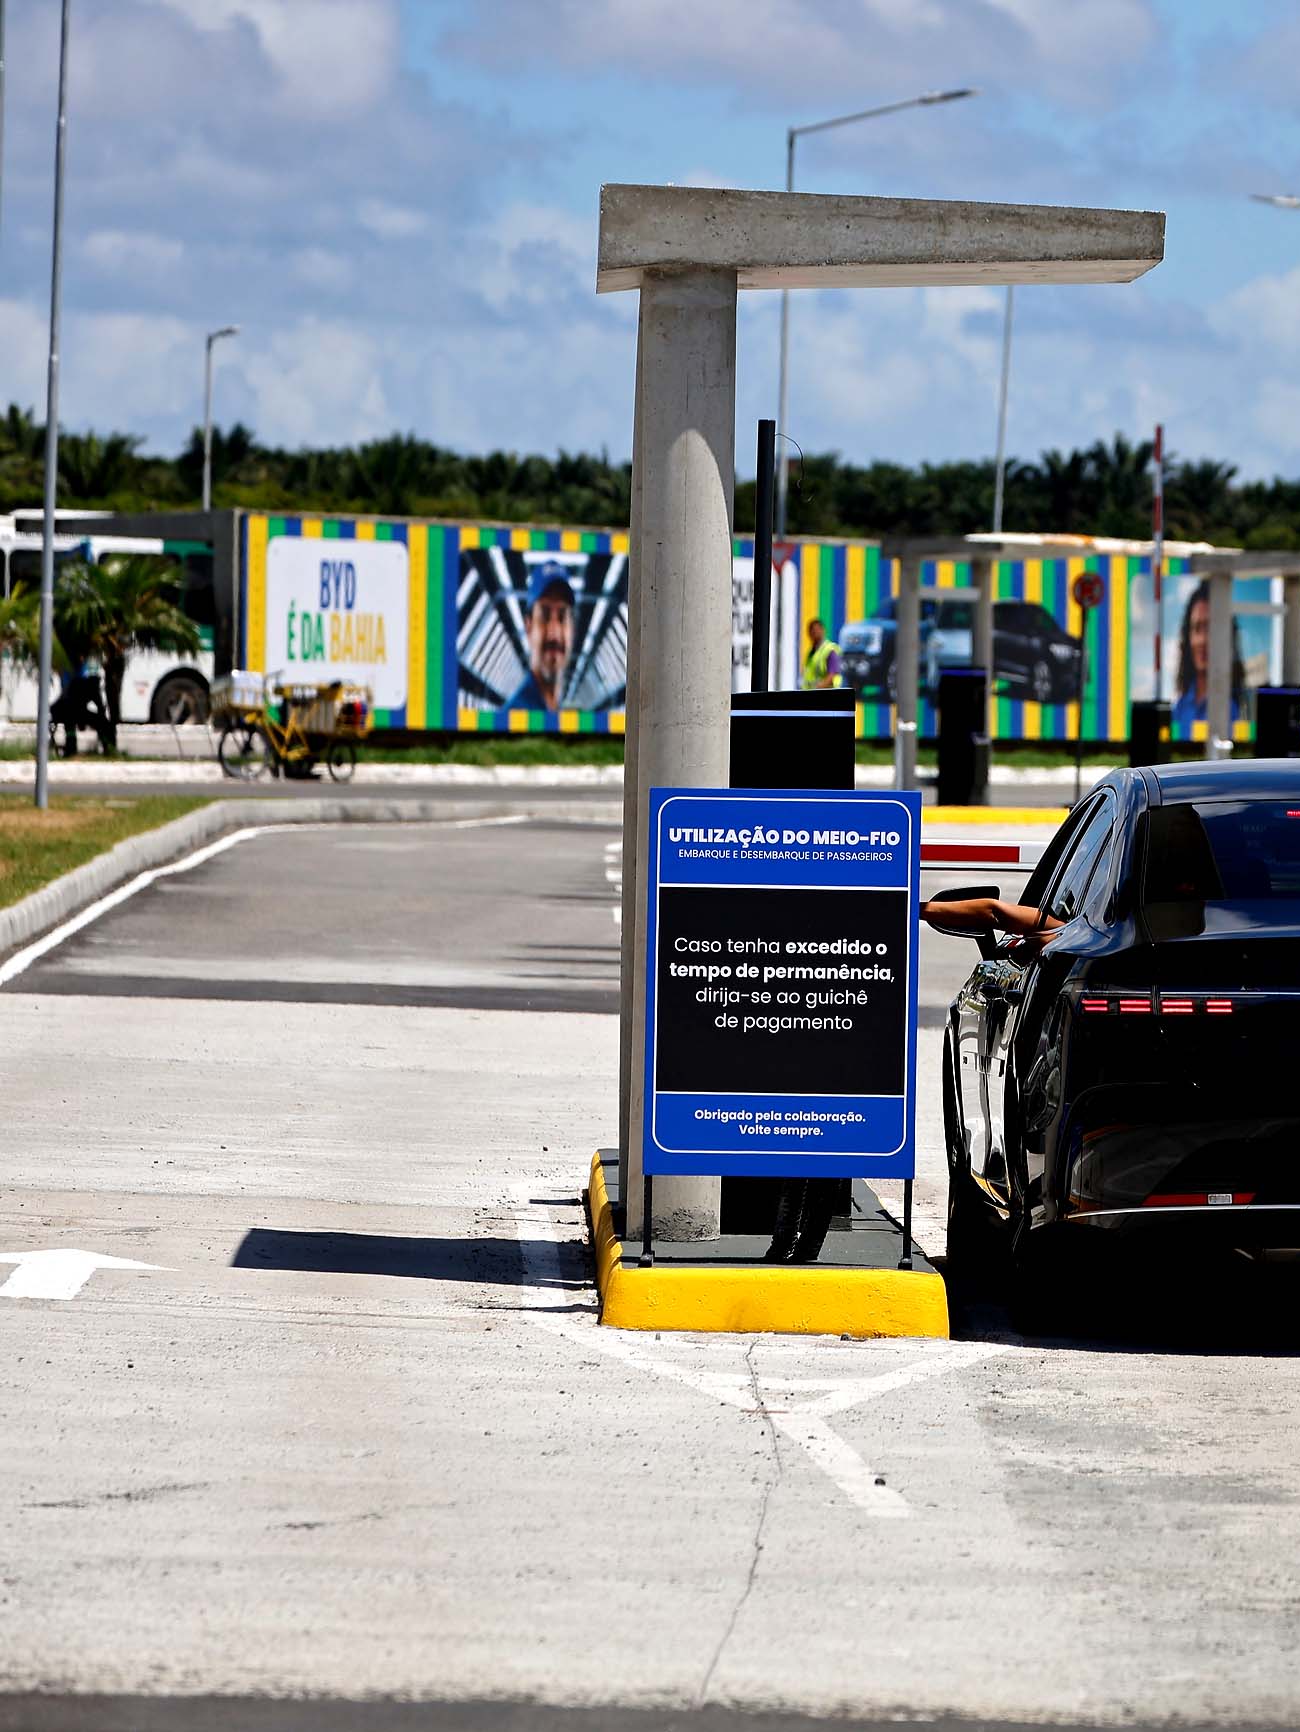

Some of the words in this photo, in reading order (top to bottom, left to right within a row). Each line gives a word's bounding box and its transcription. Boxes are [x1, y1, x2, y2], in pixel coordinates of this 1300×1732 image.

[320, 560, 356, 609] BYD
[287, 598, 296, 661] É
[301, 611, 325, 661] DA
[330, 611, 386, 663] BAHIA
[669, 825, 780, 849] UTILIZAÇÃO
[782, 829, 811, 845] DO
[812, 830, 901, 846] MEIO-FIO
[678, 848, 731, 860] EMBARQUE
[732, 849, 739, 859] E
[740, 850, 810, 861] DESEMBARQUE
[812, 851, 825, 861] DE
[826, 851, 893, 862] PASSAGEIROS
[674, 937, 722, 953] Caso
[726, 937, 780, 954] tenha
[785, 938, 872, 955] excedido
[875, 943, 888, 956] o
[669, 962, 732, 983] tempo
[735, 962, 760, 979] de
[763, 963, 895, 984] permanência,
[695, 986, 772, 1008] dirija-se
[776, 991, 801, 1004] ao
[805, 988, 868, 1009] guichê
[714, 1012, 739, 1029] de
[743, 1015, 853, 1034] pagamento
[694, 1108, 754, 1125] Obrigado
[755, 1110, 782, 1124] pela
[783, 1110, 866, 1126] colaboração.
[738, 1124, 772, 1135] Volte
[773, 1126, 824, 1139] sempre.
